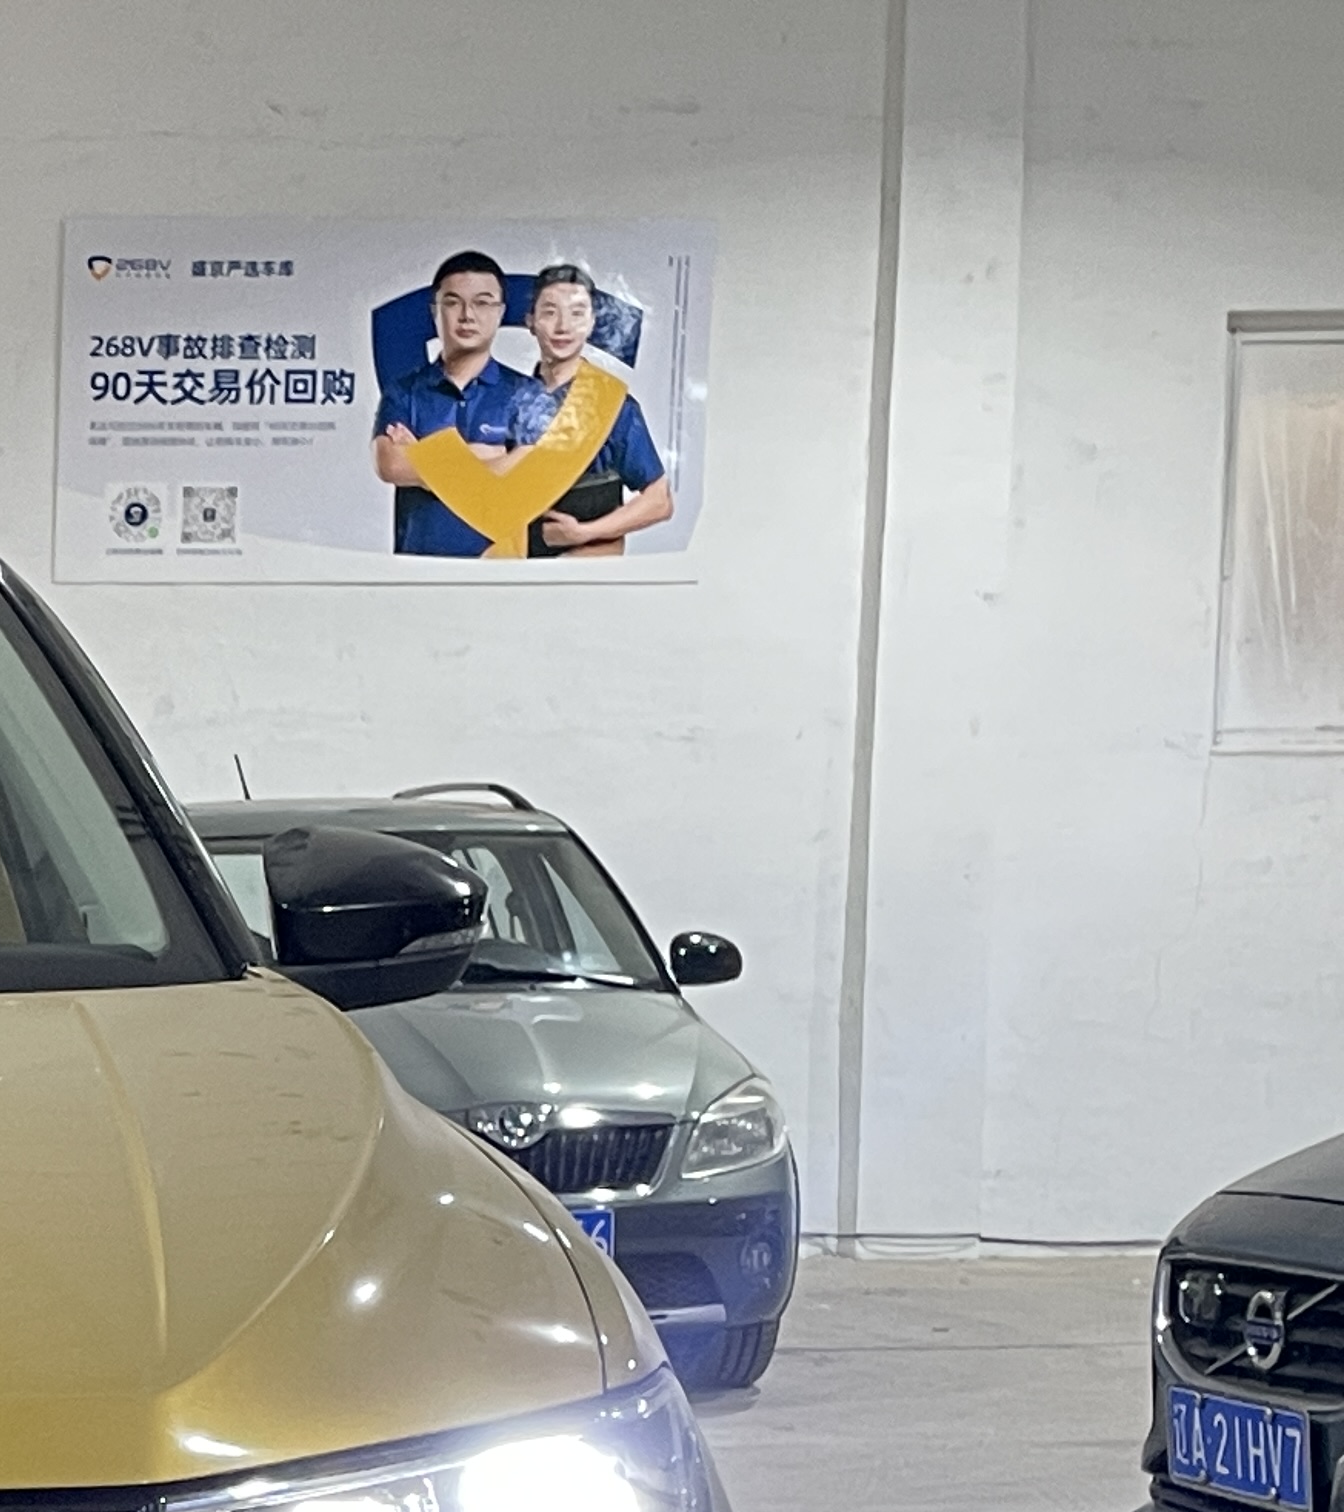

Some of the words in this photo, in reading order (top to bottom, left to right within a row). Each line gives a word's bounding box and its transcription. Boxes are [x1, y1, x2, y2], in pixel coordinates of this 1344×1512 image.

[89, 333, 316, 361] 268V事故排查检测
[90, 368, 355, 406] 90天交易价回购
